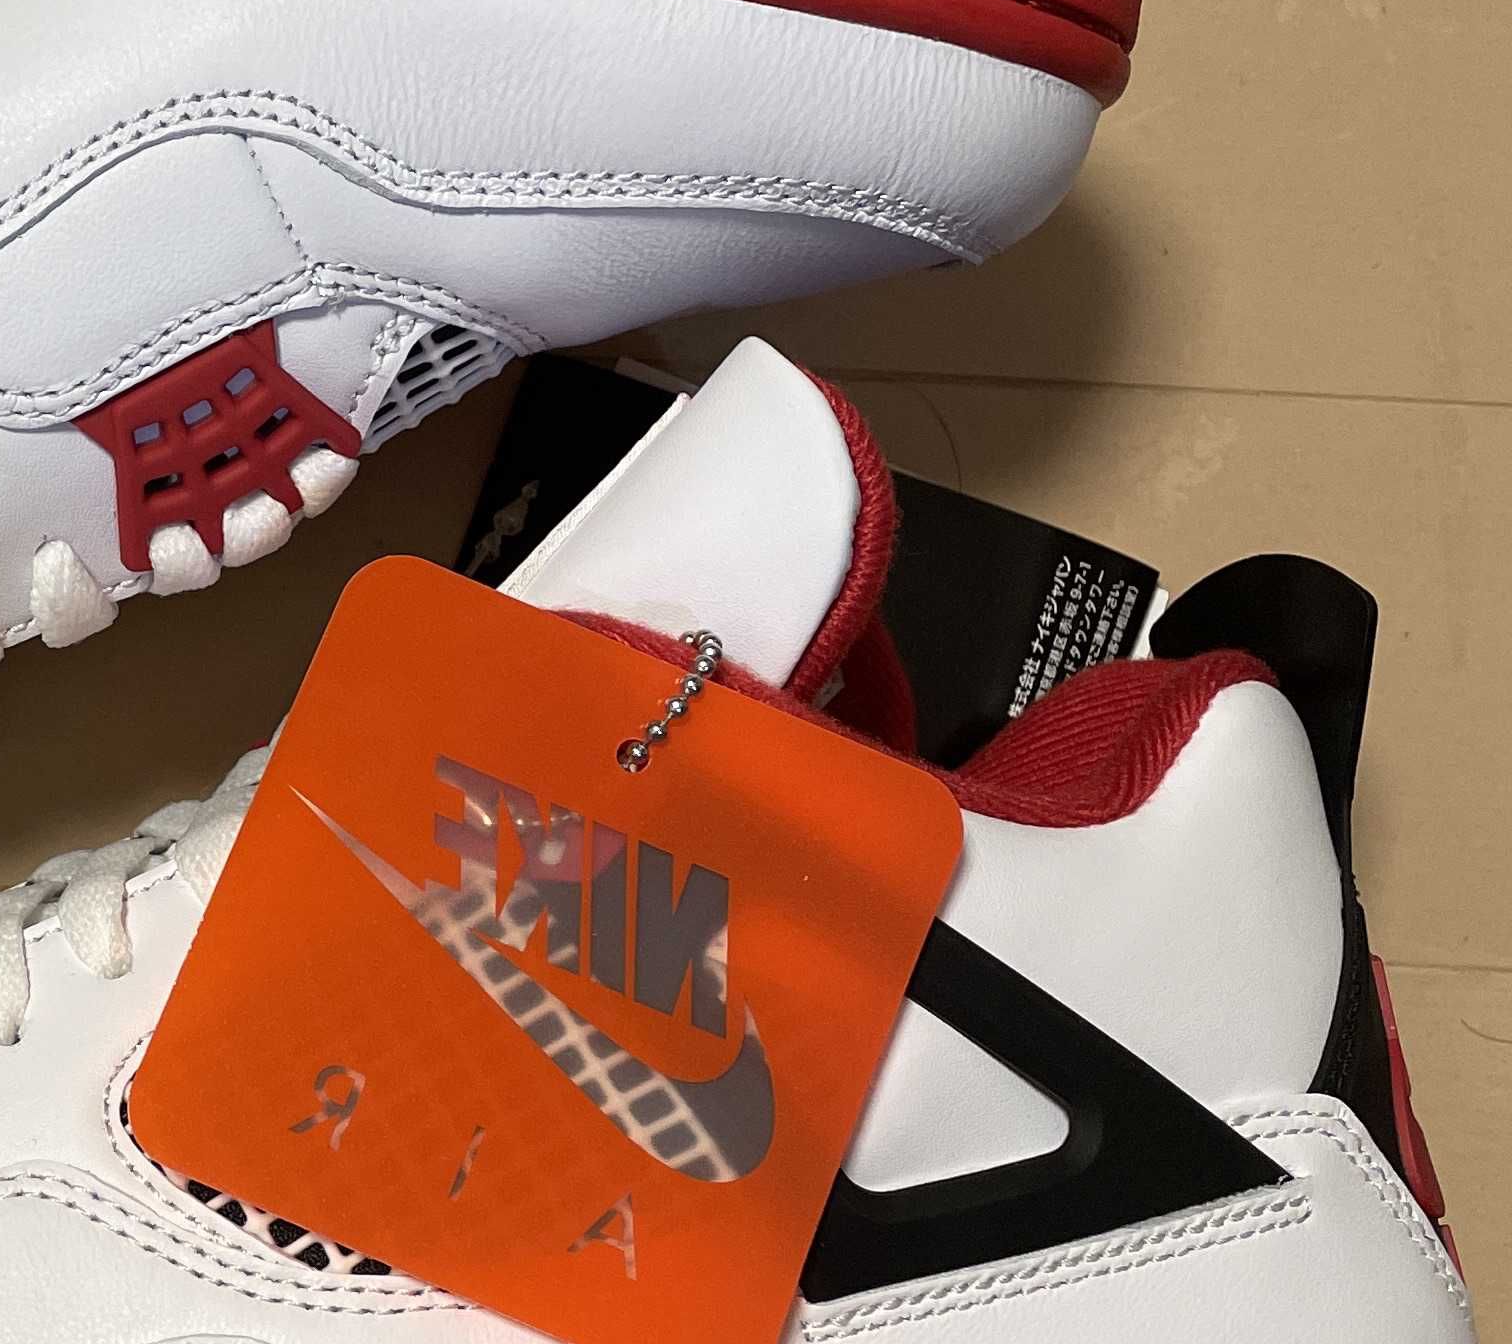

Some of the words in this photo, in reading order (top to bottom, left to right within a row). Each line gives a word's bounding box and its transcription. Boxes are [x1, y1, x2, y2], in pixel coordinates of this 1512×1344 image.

[1069, 561, 1092, 600] 9-7-1
[1007, 656, 1041, 718] 株式会社
[1031, 555, 1072, 654] ナイキジャパン
